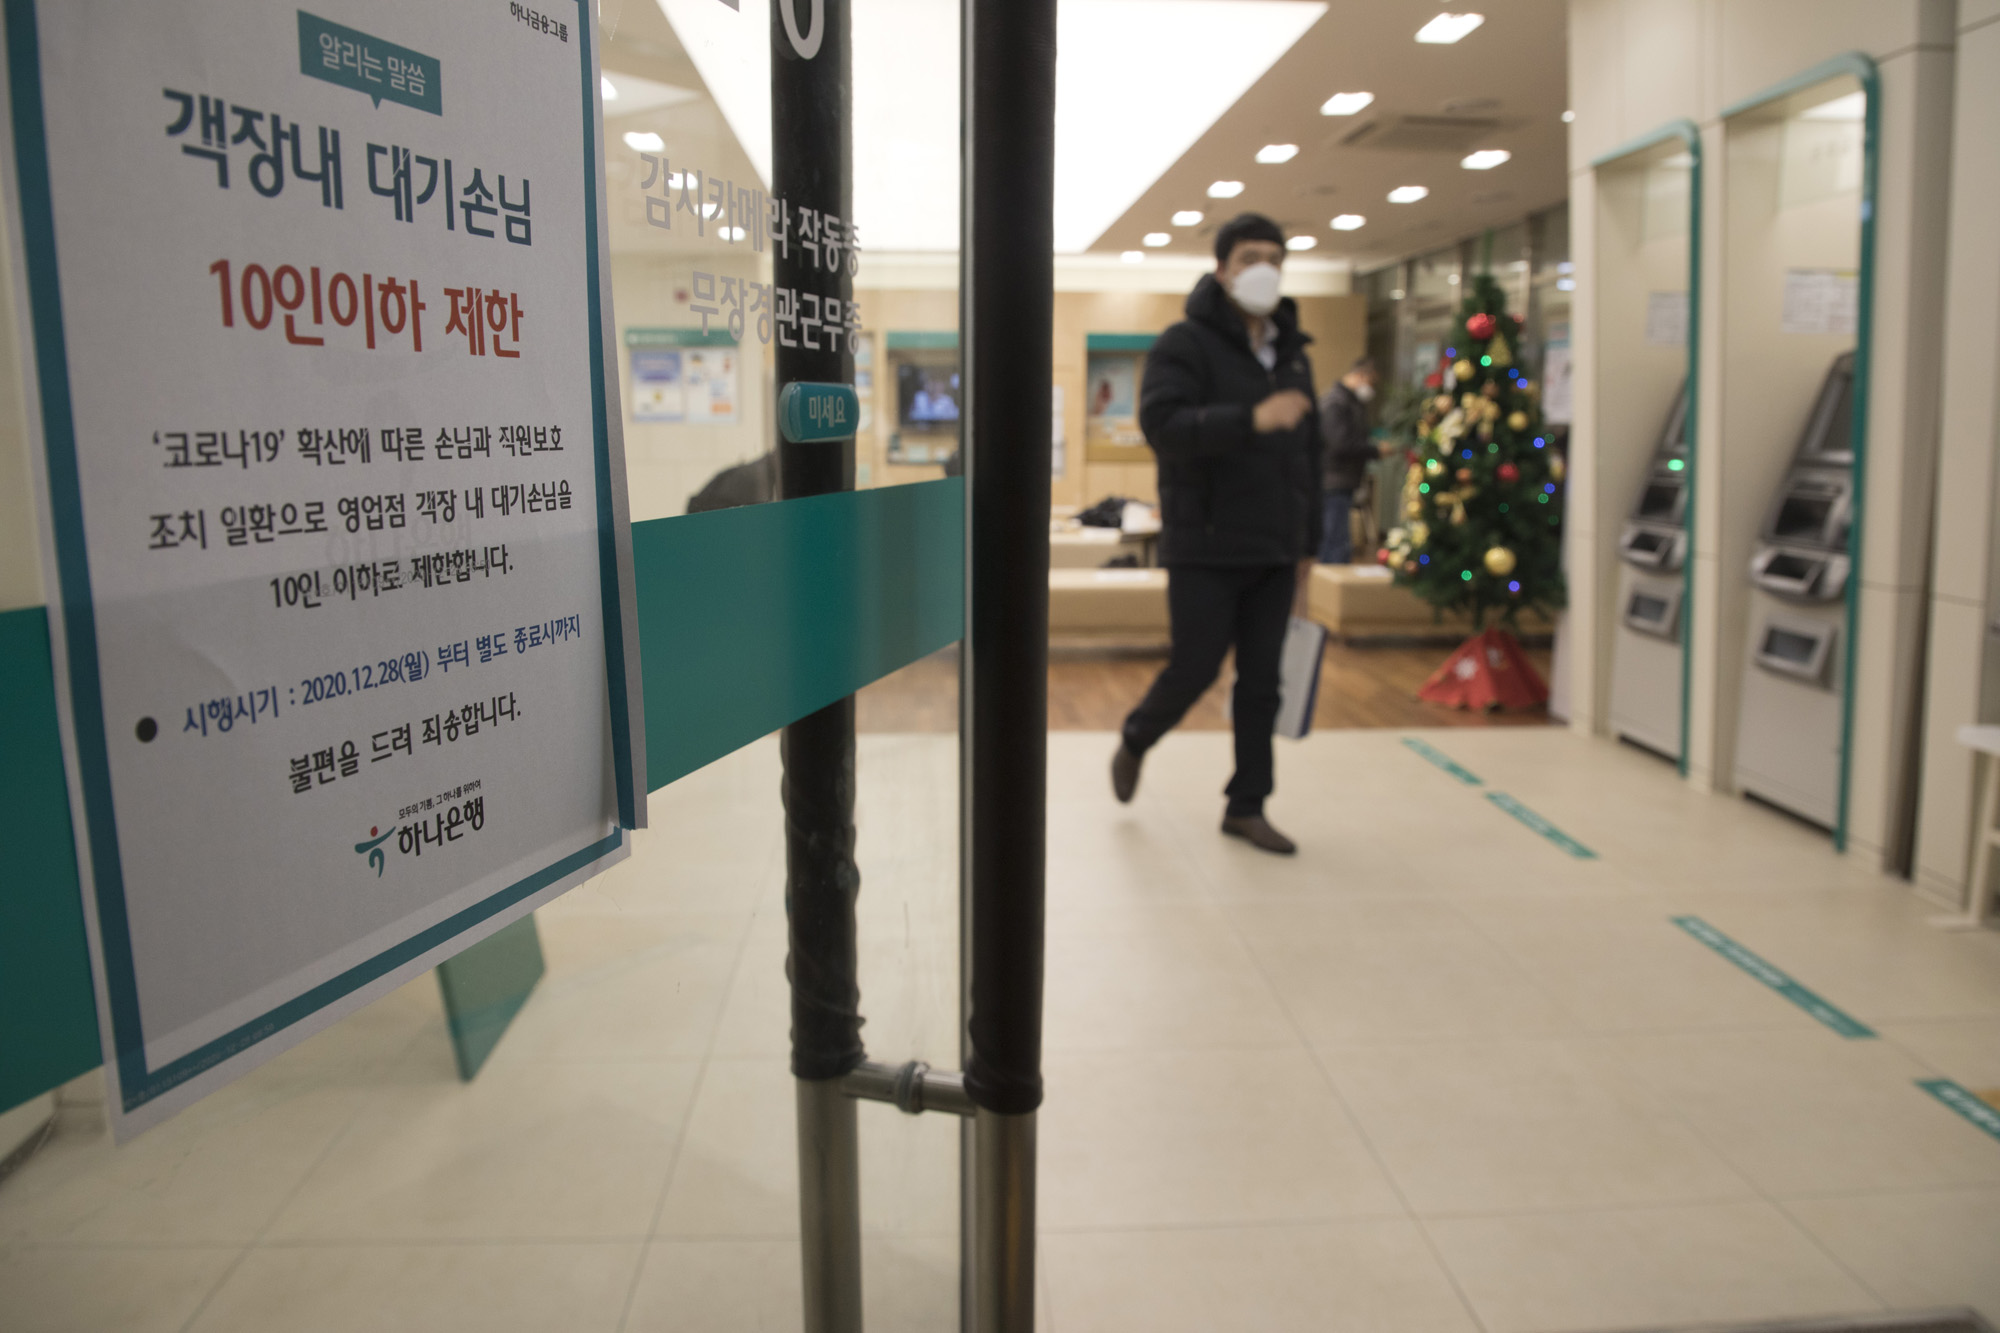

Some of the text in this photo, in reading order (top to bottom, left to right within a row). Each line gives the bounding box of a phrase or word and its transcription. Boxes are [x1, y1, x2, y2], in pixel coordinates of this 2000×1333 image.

[510, 1, 568, 43] 하나금융그룹
[319, 33, 425, 96] 알리는 말씀
[163, 87, 532, 246] 객장내 대기손님
[641, 153, 861, 277] 감시카메라 작동중
[210, 259, 524, 358] 10인이하 제한
[690, 271, 862, 355] 무장경관근무중
[809, 395, 846, 429] 미세요
[153, 425, 564, 469] ‘코로나19’ 확산에 따른 손님과 직원보호
[149, 509, 206, 550] 조치
[221, 502, 328, 547] 일환으로
[338, 493, 406, 533] 영업점
[416, 489, 457, 524] 객장
[465, 487, 484, 519] 내
[491, 479, 572, 516] 대기손님을
[270, 569, 322, 609] 10인
[333, 561, 403, 601] 이하로
[411, 544, 514, 588] 제한합니다.
[183, 686, 279, 737] 시행시기
[301, 651, 430, 705] 2020.12.28(월)
[437, 640, 469, 673] 부터
[476, 632, 508, 663] 별도
[514, 613, 581, 654] 종료시까지
[289, 692, 521, 794] 불편을 드려 죄송합니다.
[397, 796, 485, 857] 하나은행
[398, 803, 419, 820] 모두의
[443, 786, 462, 802] 하나를
[463, 779, 482, 794] 위하여
